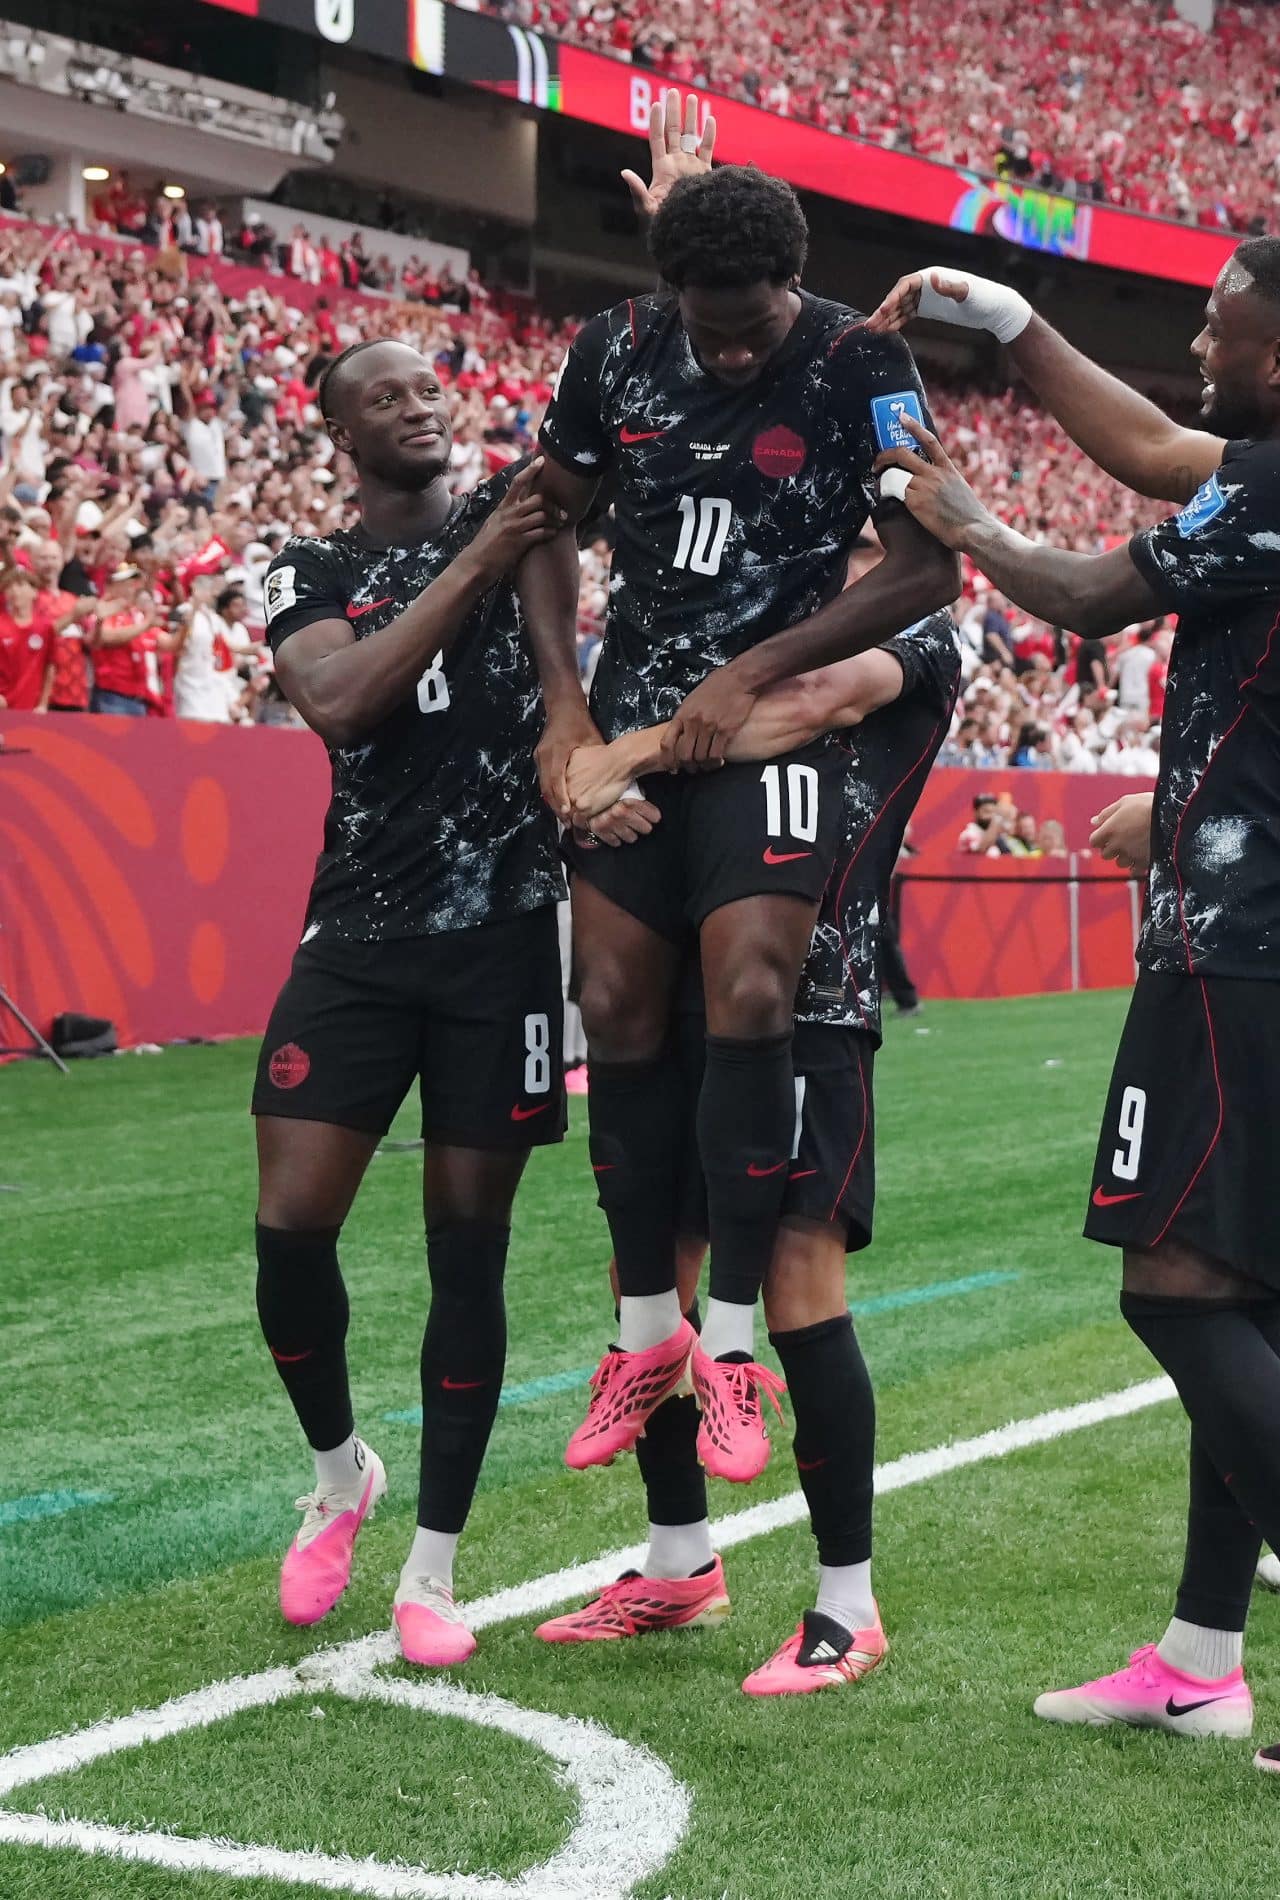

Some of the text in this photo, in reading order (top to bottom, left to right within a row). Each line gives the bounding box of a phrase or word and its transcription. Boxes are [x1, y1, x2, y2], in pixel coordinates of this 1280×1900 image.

[754, 447, 804, 458] CANADA
[672, 494, 732, 576] 10
[760, 763, 819, 844] 10
[524, 1013, 550, 1094] 8
[1111, 1085, 1147, 1181] 9
